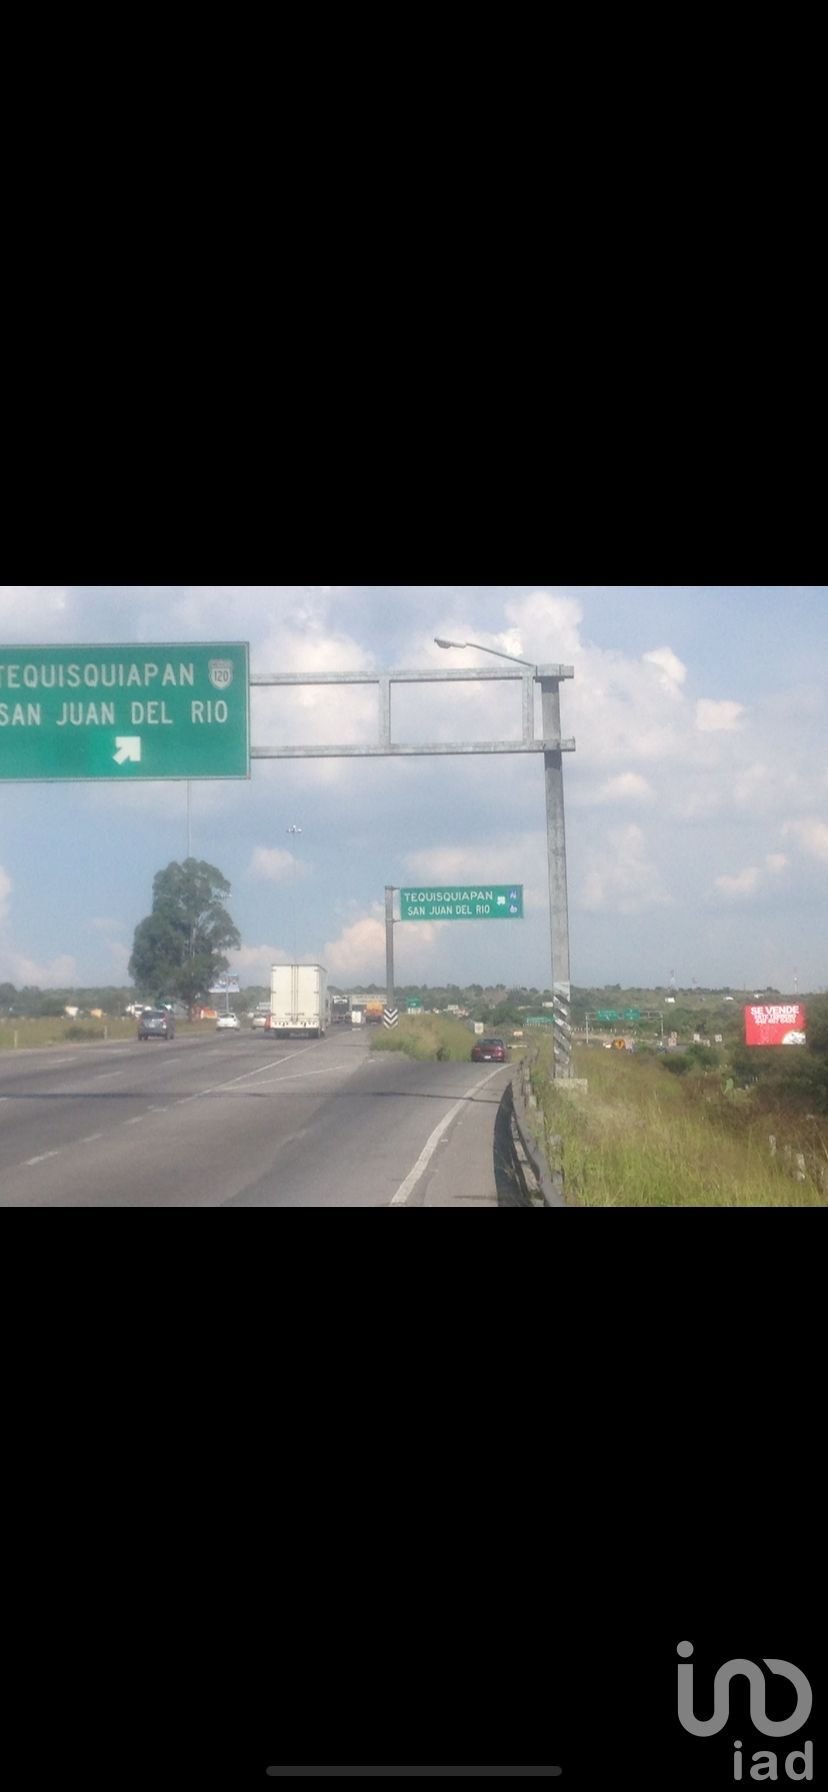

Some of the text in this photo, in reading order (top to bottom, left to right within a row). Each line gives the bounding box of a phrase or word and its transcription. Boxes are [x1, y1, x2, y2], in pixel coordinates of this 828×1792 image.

[214, 670, 229, 682] 120
[0, 700, 228, 726] SAN JUAN DEL RIO
[404, 891, 494, 902] TEQUISQUIAPAN
[408, 904, 490, 916] SAN JUAN DEL RIO
[750, 1005, 799, 1015] SE VENDE
